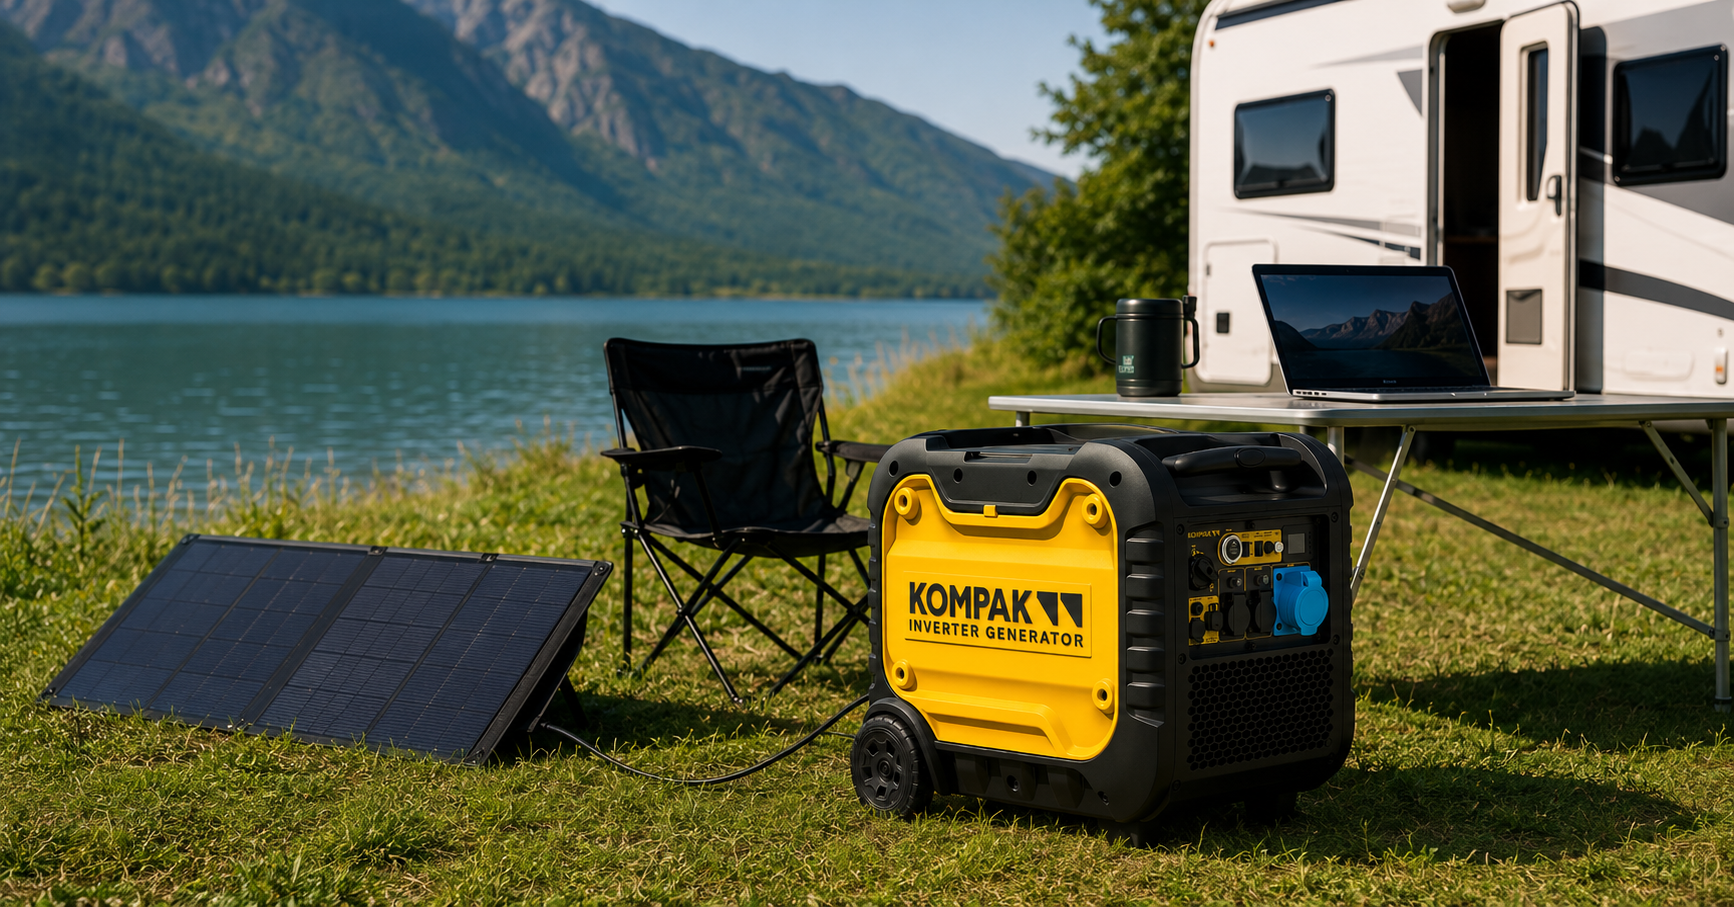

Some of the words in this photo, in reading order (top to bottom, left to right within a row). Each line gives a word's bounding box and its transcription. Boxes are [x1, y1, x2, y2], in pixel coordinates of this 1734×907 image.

[909, 581, 1033, 624] KOMPAK
[909, 618, 979, 638] INVERTER
[985, 626, 1084, 648] GENERATOR
